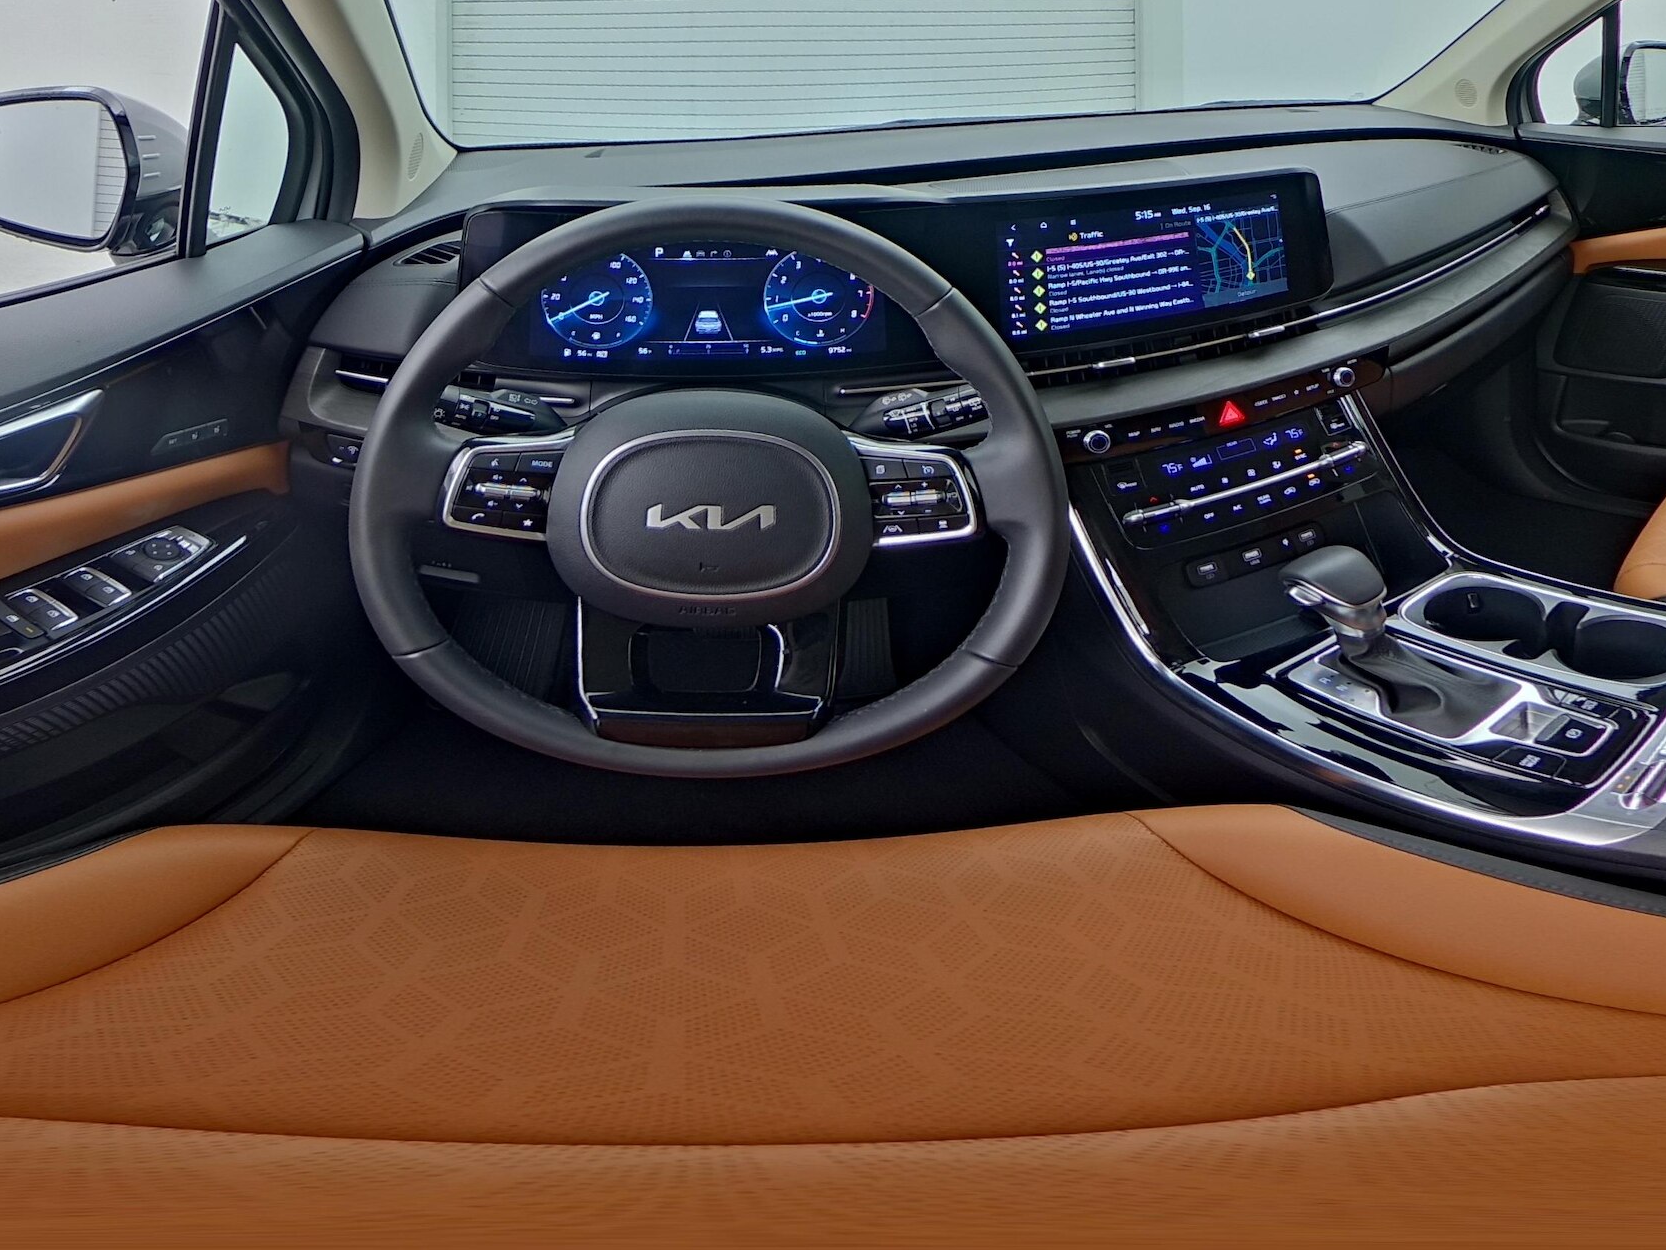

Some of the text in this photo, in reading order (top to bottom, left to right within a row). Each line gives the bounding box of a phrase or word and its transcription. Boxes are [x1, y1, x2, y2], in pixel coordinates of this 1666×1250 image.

[1135, 210, 1154, 221] 5:15
[1203, 203, 1211, 211] 16
[1079, 231, 1104, 240] Traffic
[655, 247, 664, 257] P
[609, 261, 622, 269] 100
[795, 261, 802, 269] 3
[626, 277, 638, 285] 120
[780, 276, 787, 284] 2
[1114, 271, 1151, 282] Southbound
[1137, 284, 1171, 295] Westbound
[551, 293, 561, 301] 20
[632, 296, 644, 304] 140
[851, 309, 857, 318] 8
[1076, 312, 1102, 320] Wheeler
[1135, 302, 1159, 312] Winning
[1160, 301, 1172, 309] Way
[625, 315, 637, 323] 160
[782, 314, 788, 322] 0
[531, 459, 553, 468] MODE
[1190, 484, 1205, 492] AUTO
[646, 503, 777, 530] KIA
[679, 606, 736, 616] AIRBAG
